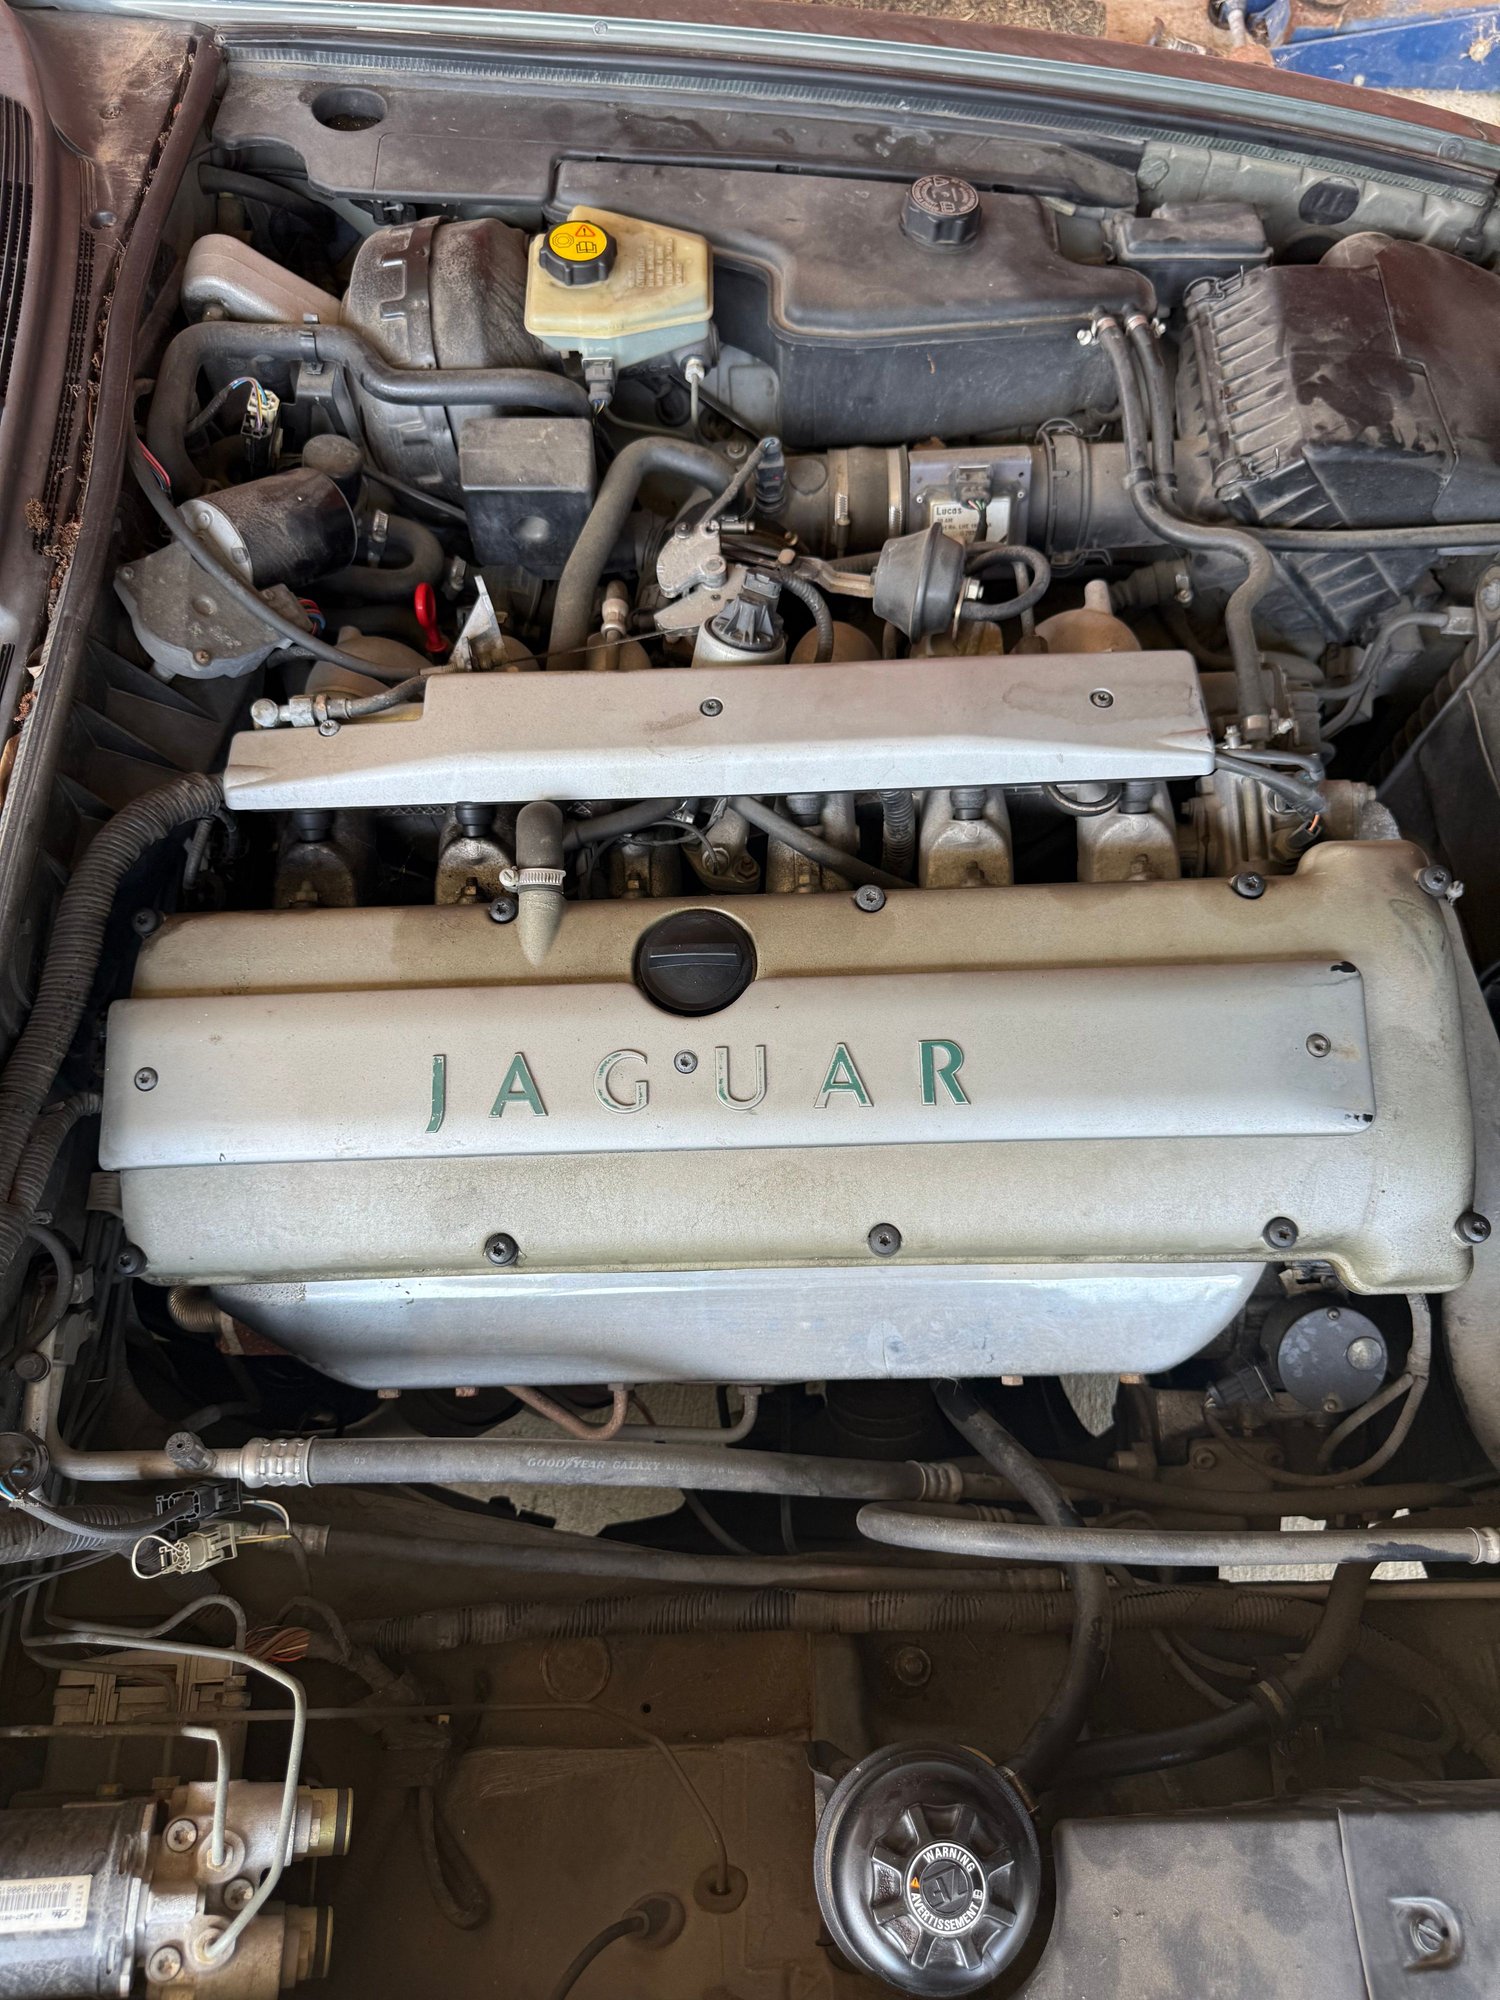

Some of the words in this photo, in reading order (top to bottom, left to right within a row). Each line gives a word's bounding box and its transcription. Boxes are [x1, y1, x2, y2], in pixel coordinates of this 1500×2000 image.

[936, 507, 962, 516] Lucas
[425, 1039, 972, 1133] JAGUAR
[527, 1456, 606, 1470] GOODYEAR
[612, 1459, 661, 1472] GALAXY
[923, 1846, 976, 1873] WARNING
[911, 1892, 980, 1931] AVERTISSEMENT
